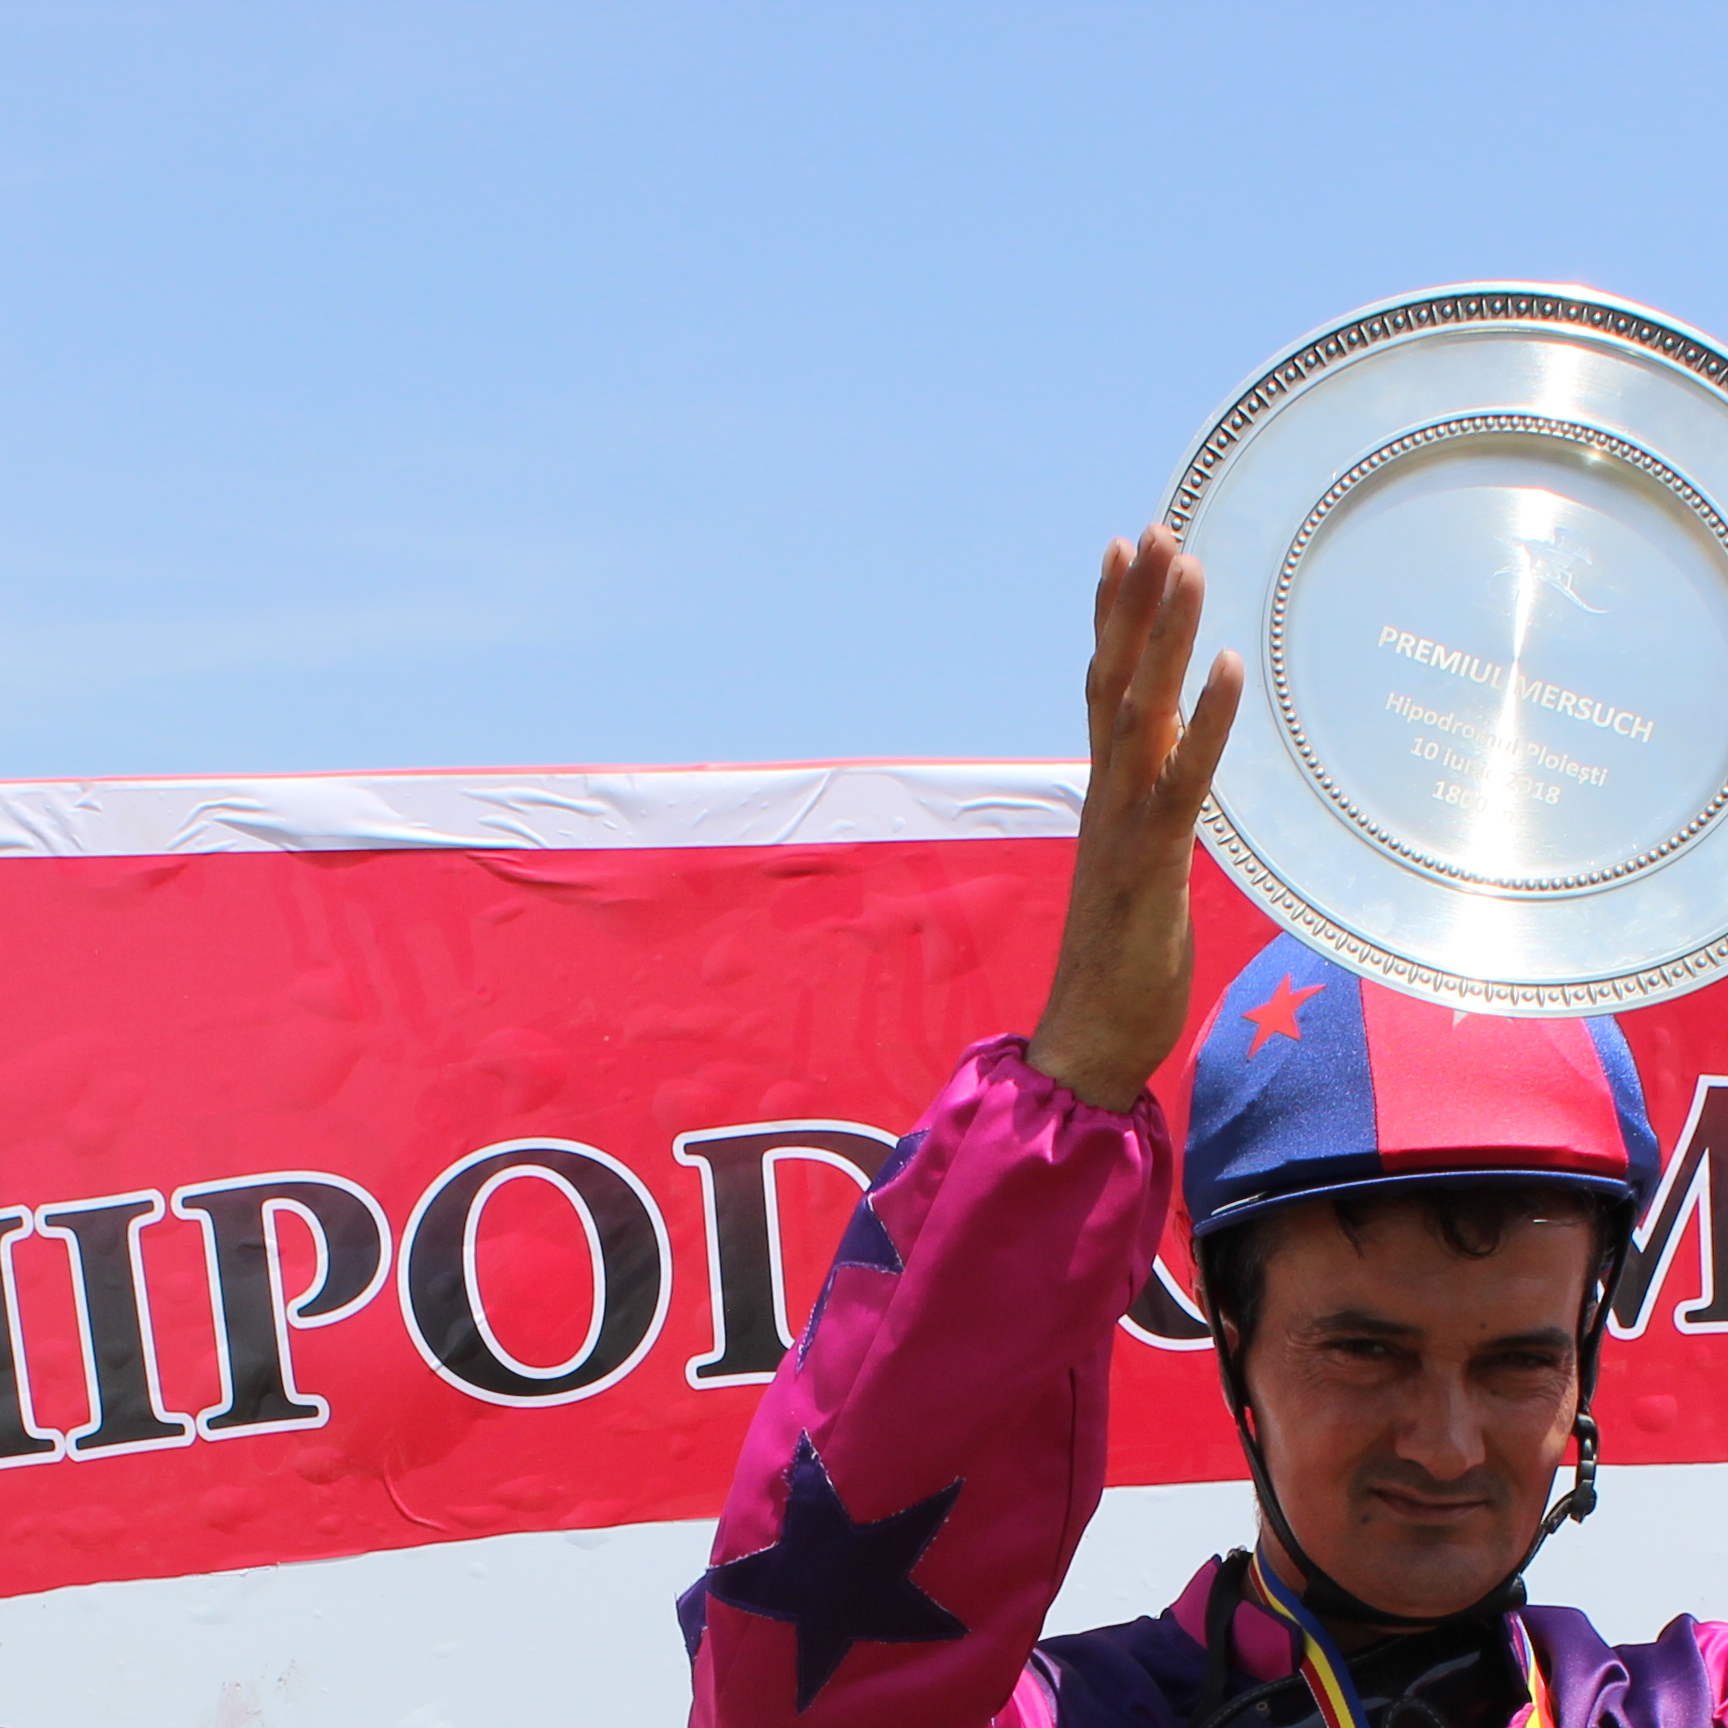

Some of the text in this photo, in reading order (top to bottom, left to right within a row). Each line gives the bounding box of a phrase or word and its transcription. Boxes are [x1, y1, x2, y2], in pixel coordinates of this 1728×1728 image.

[1377, 625, 1656, 744] PREMIUL MERSUCH
[1410, 736, 1440, 762] 10
[1506, 771, 1562, 805] 2018
[1526, 742, 1609, 788] Ploiești
